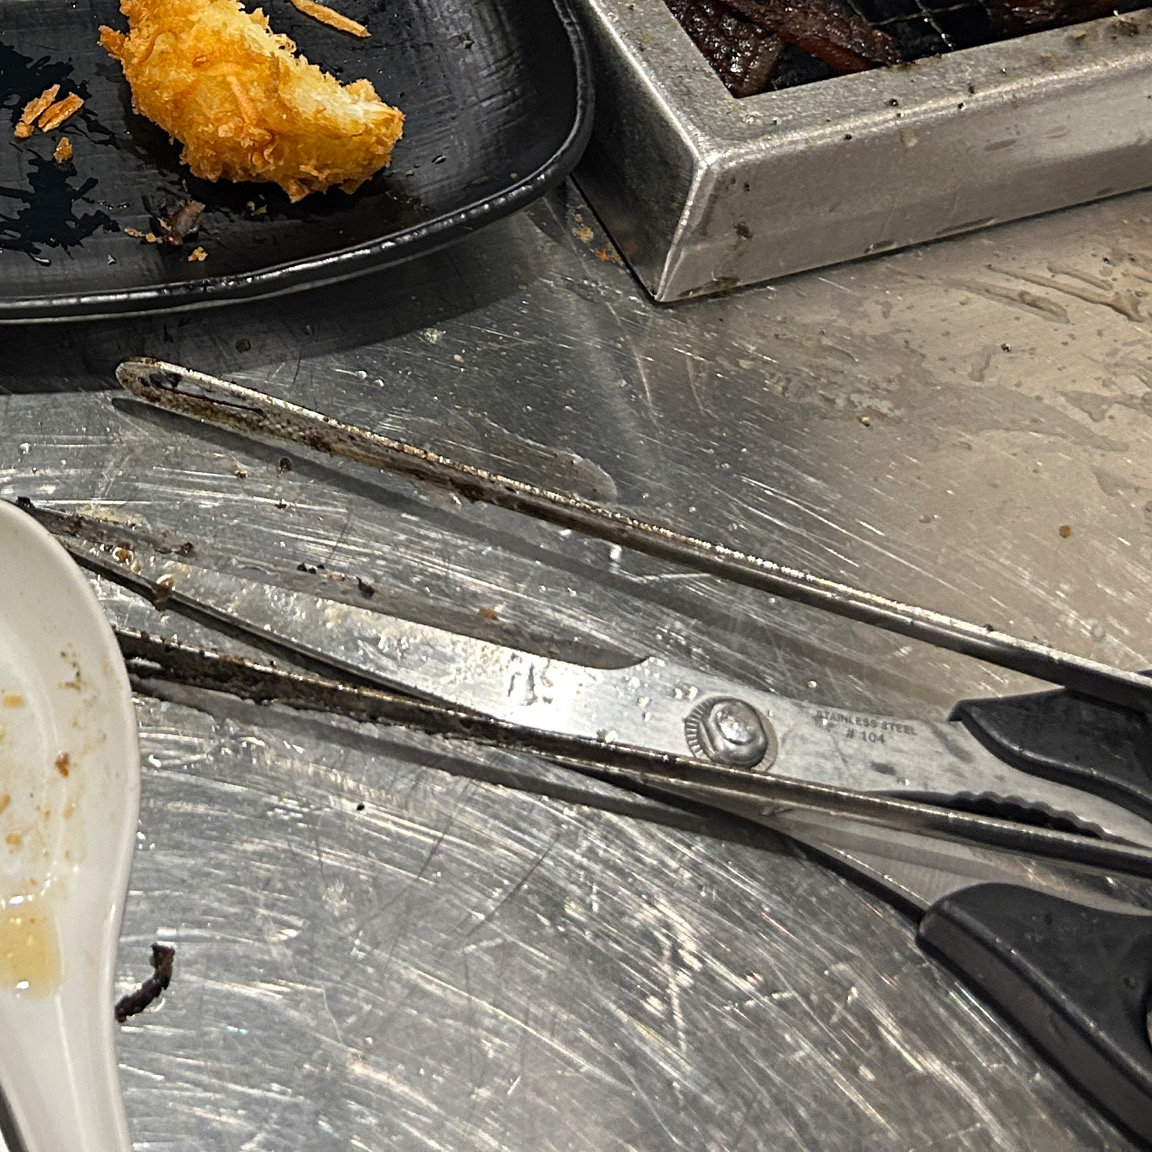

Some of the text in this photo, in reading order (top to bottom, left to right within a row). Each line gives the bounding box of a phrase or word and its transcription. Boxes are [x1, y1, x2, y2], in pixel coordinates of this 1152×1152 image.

[815, 710, 917, 735] STAINLESS STEEL
[861, 730, 885, 744] 104
